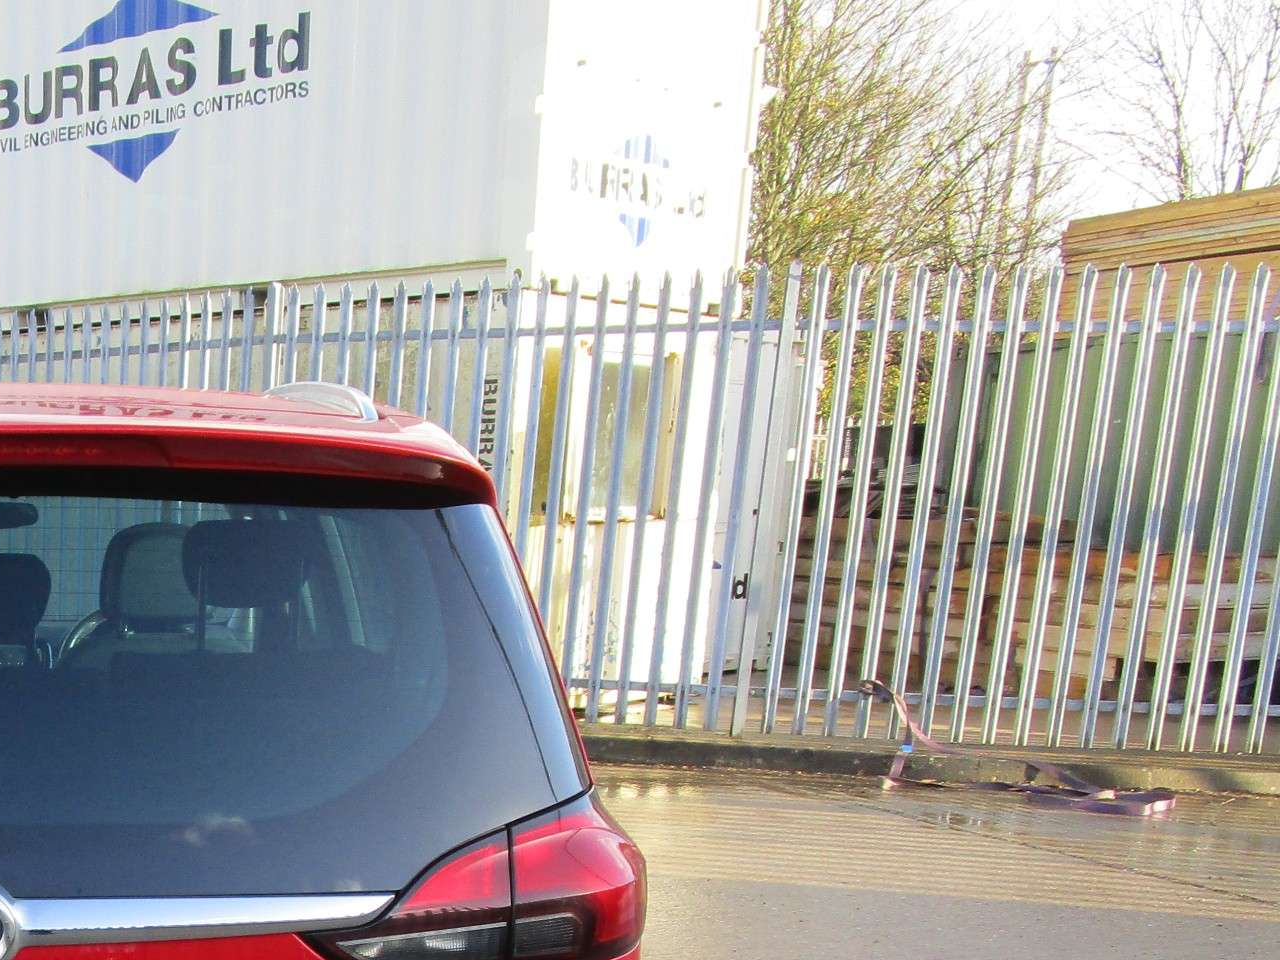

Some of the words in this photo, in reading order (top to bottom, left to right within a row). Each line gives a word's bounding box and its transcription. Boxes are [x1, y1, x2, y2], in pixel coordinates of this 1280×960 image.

[217, 11, 311, 85] Ltd
[111, 114, 141, 133] AND
[143, 103, 186, 125] PILING
[193, 81, 310, 117] CONTRACTORS
